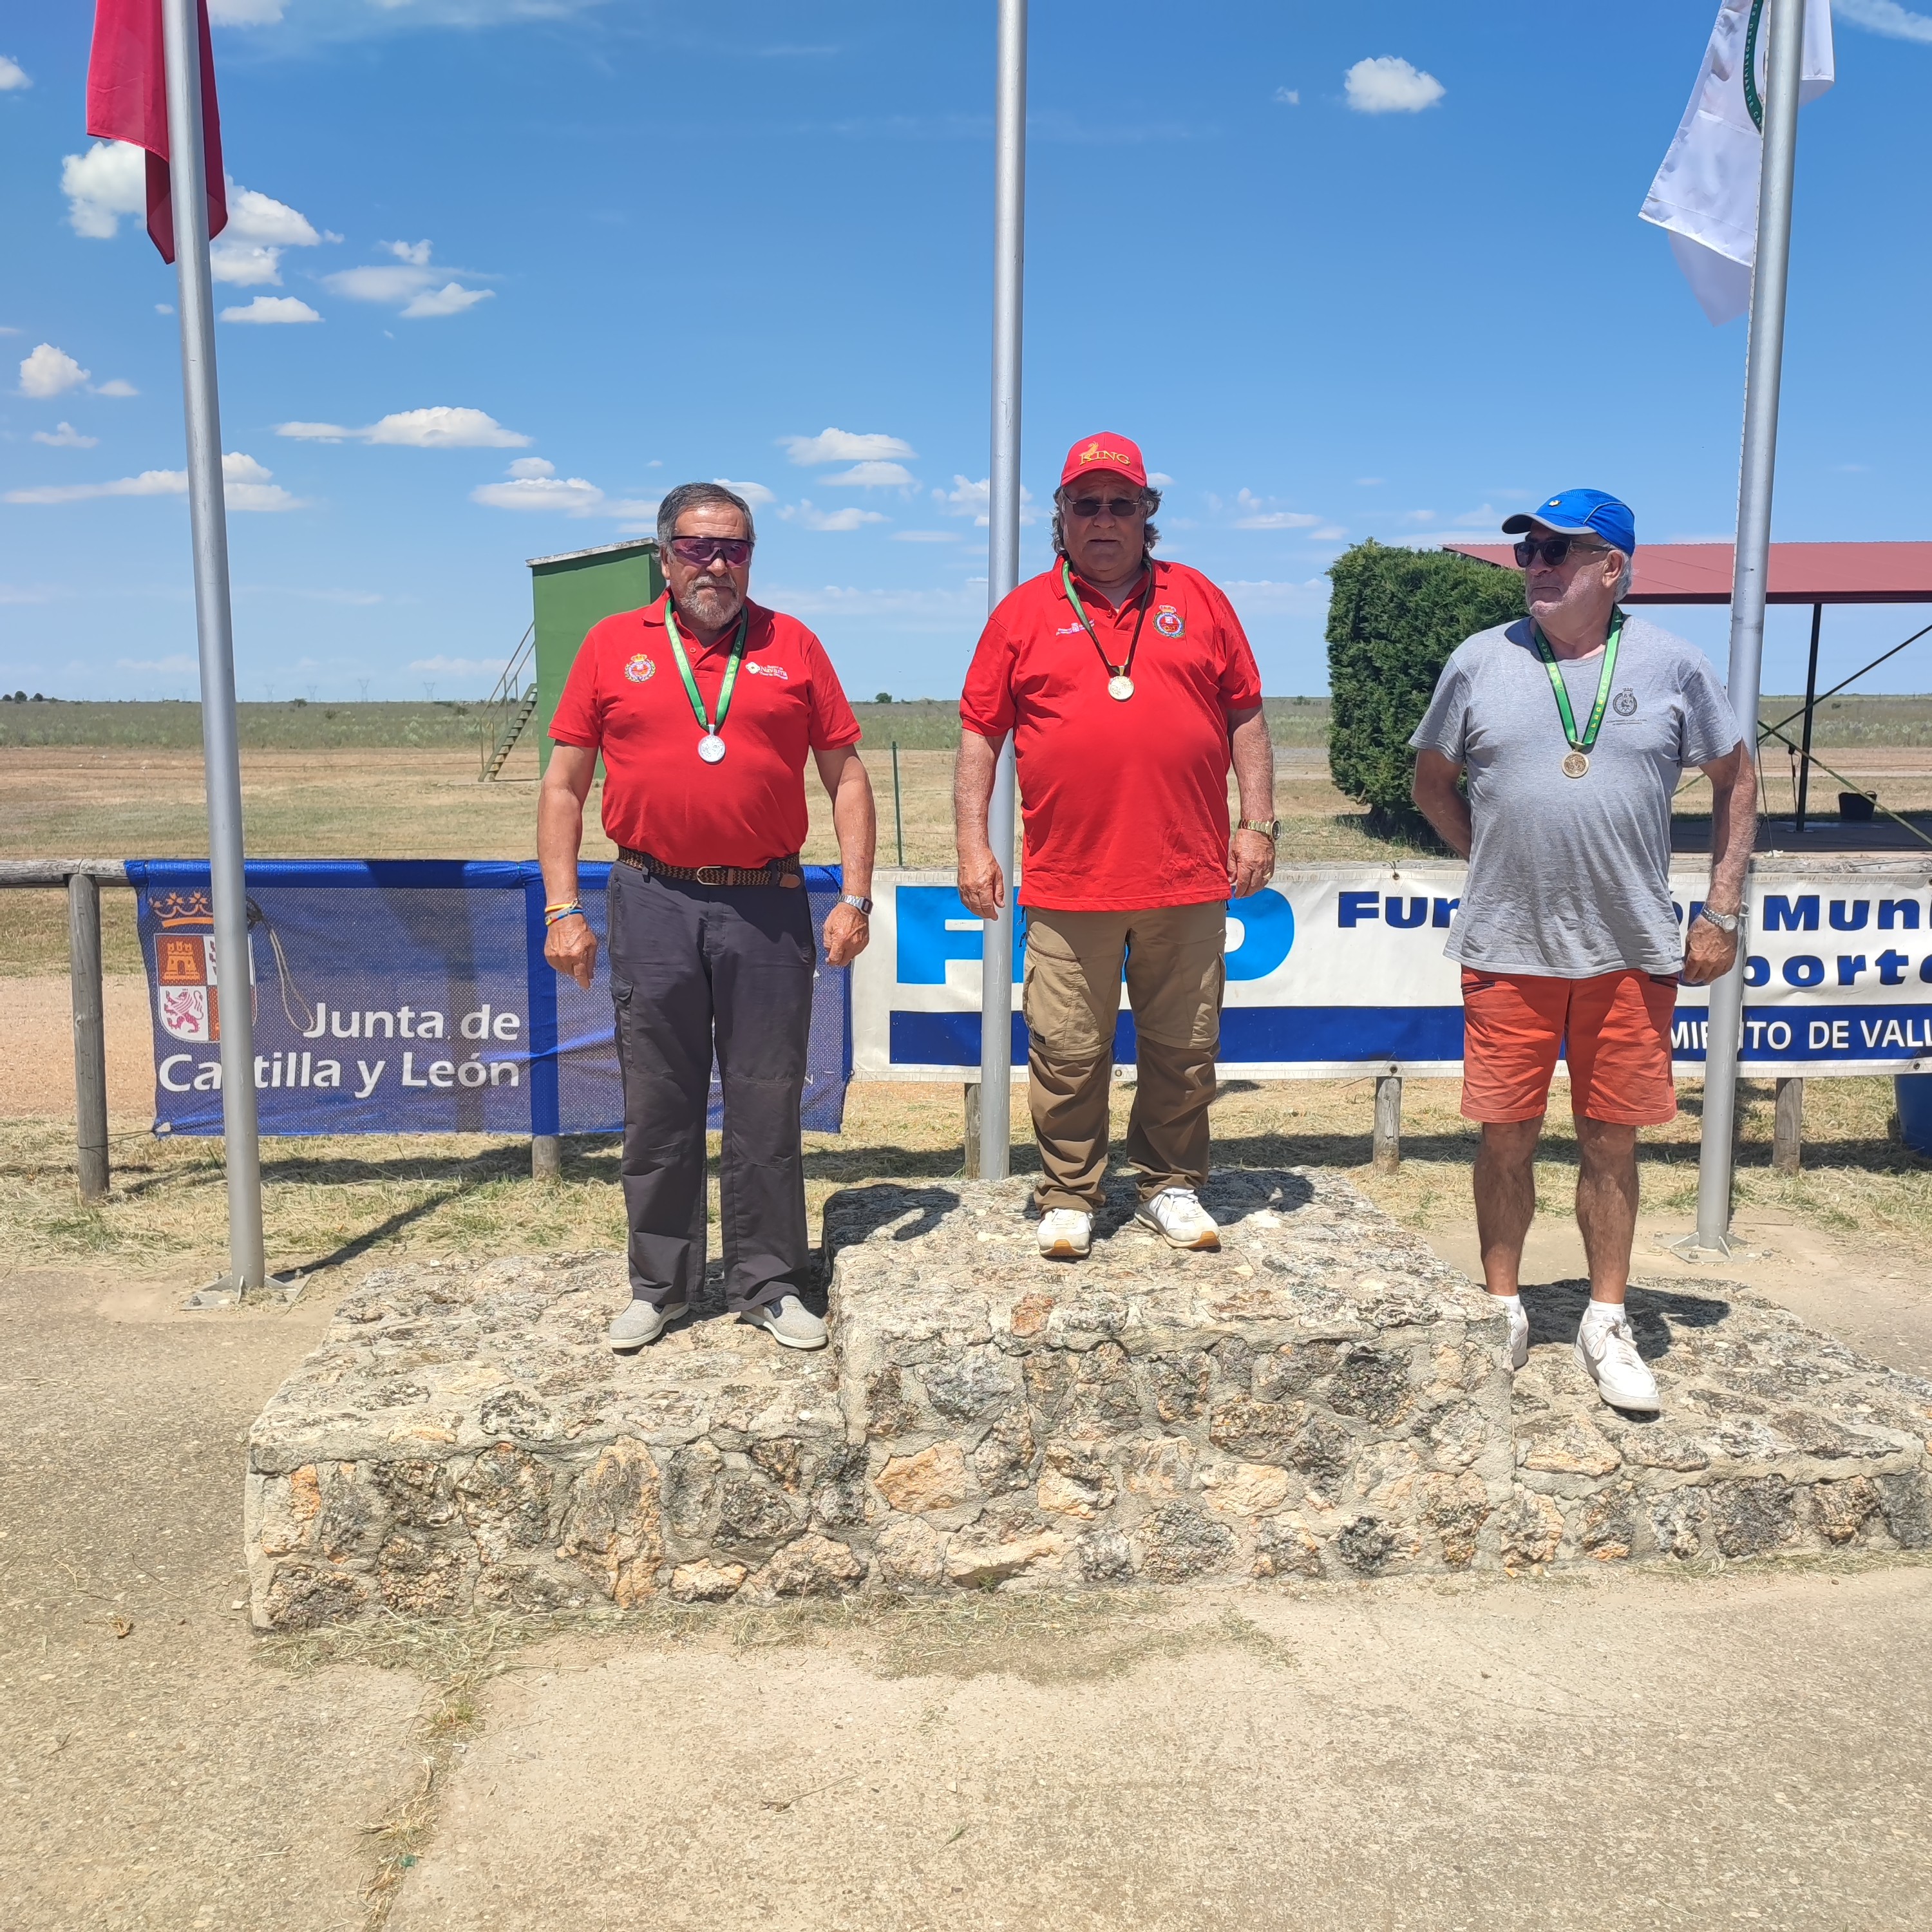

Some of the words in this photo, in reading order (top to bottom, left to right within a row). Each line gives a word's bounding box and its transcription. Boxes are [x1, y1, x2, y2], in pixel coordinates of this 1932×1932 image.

[1079, 450, 1131, 466] KING
[1763, 895, 1932, 931] Mun
[303, 1003, 444, 1038] Junta
[460, 1004, 520, 1041] de
[1809, 1021, 1849, 1049] DE
[159, 1052, 341, 1092] Catilla
[354, 1060, 385, 1099] y
[401, 1051, 519, 1089] León
